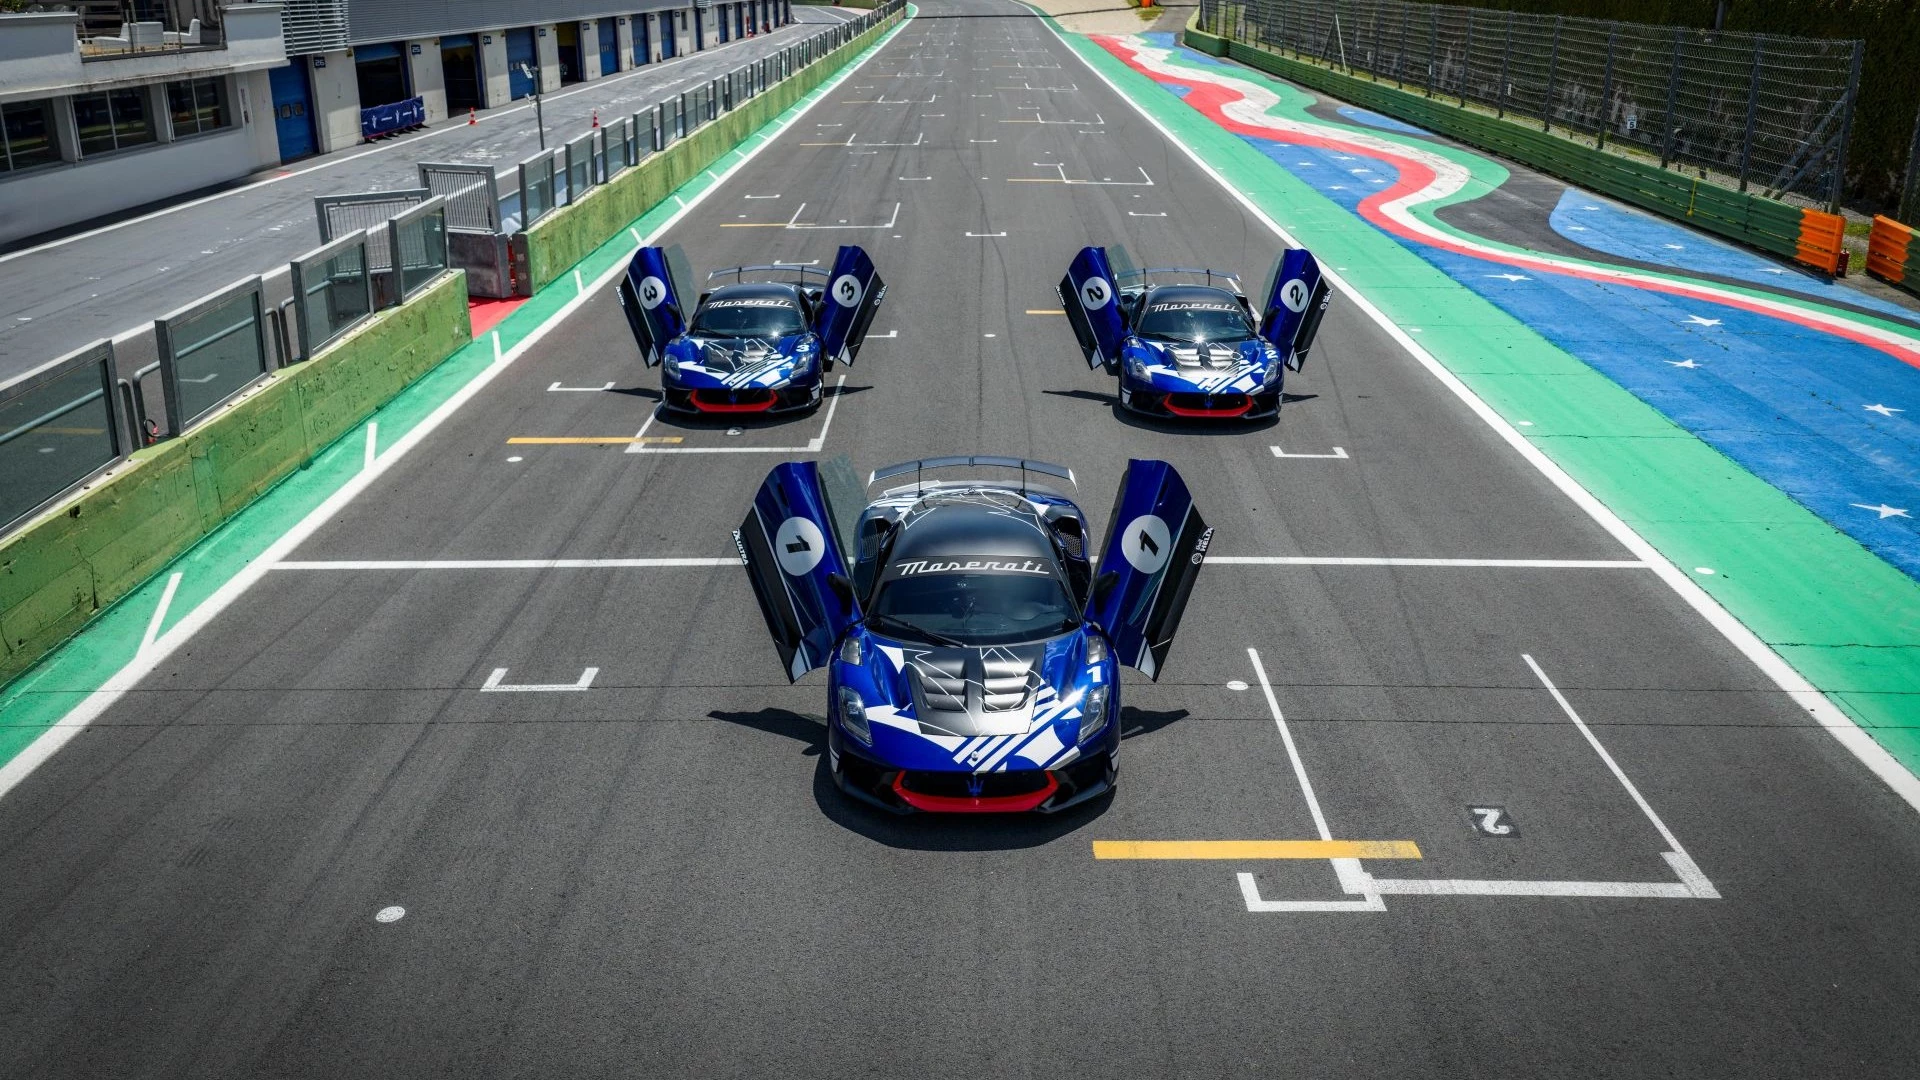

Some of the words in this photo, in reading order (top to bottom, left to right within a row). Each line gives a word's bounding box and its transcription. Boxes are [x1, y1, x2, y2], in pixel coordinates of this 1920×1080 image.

[643, 285, 658, 302] 3
[841, 281, 855, 301] 3
[1086, 285, 1105, 302] 2
[1290, 284, 1304, 307] 2
[708, 300, 794, 309] Maserati
[1151, 303, 1240, 313] Maserati
[795, 344, 810, 353] 3
[1264, 349, 1279, 360] 2
[785, 534, 811, 554] 1
[1138, 529, 1160, 557] 1
[1200, 527, 1214, 552] HELIX
[736, 540, 749, 566] ULTRA
[895, 560, 1050, 576] Maserati
[1086, 665, 1103, 683] 1
[1473, 808, 1510, 834] 2
